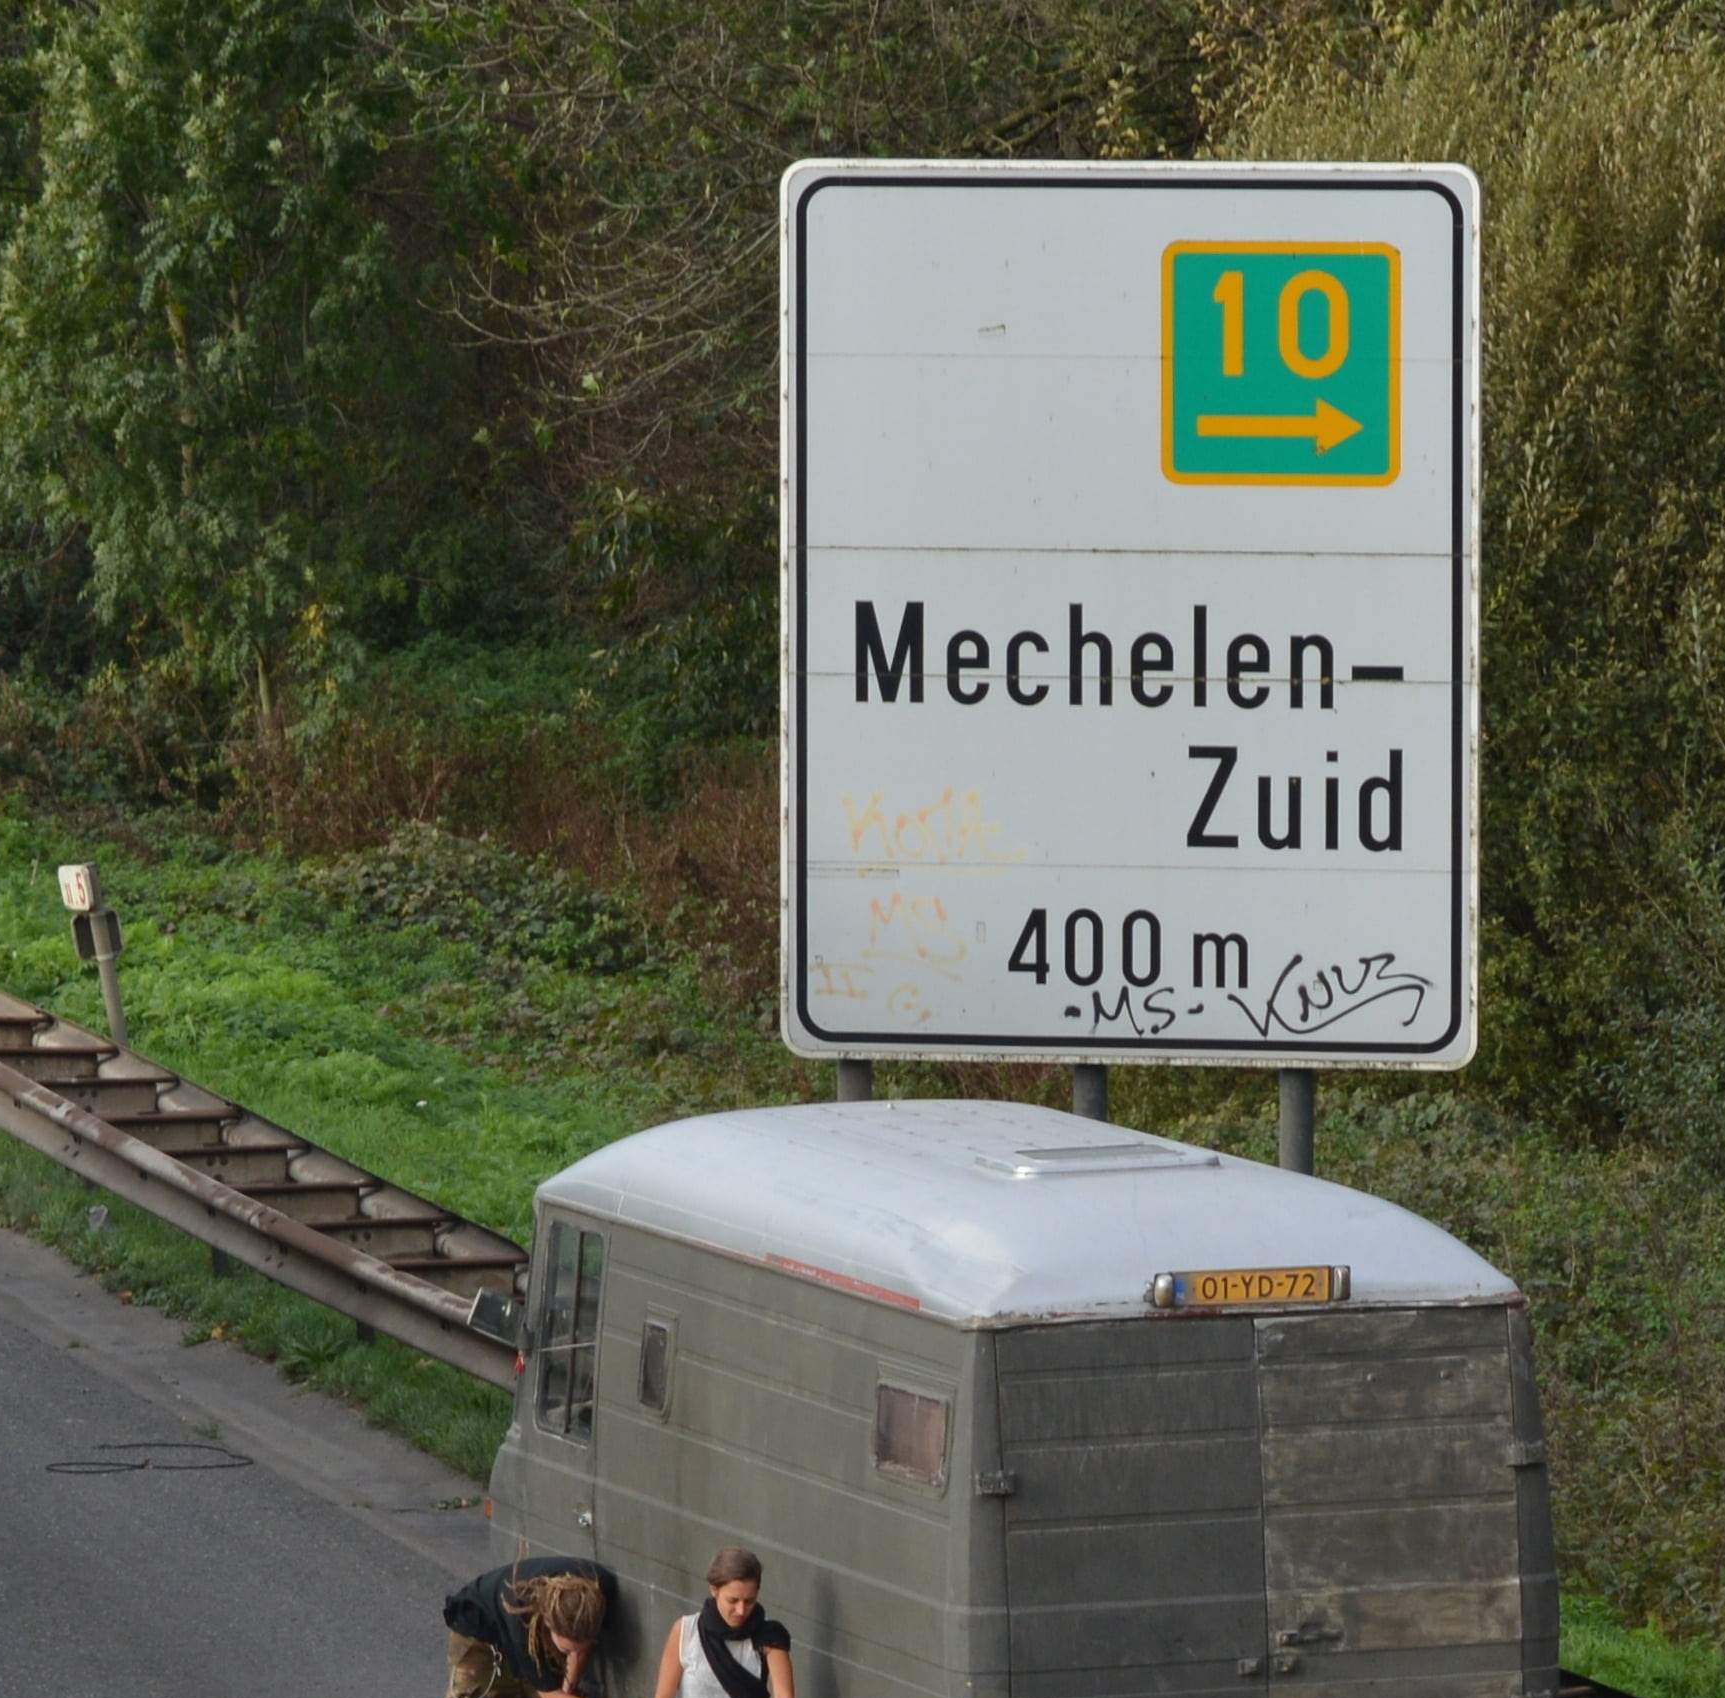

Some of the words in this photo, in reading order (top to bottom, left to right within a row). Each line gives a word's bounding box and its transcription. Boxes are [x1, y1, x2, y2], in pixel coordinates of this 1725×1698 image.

[1212, 269, 1351, 380] 10
[854, 600, 1406, 711] Mechelen-
[1187, 745, 1405, 853] Zuid
[1007, 907, 1162, 988] 400
[1191, 932, 1249, 989] m
[1200, 1273, 1317, 1300] 01-YD-72
